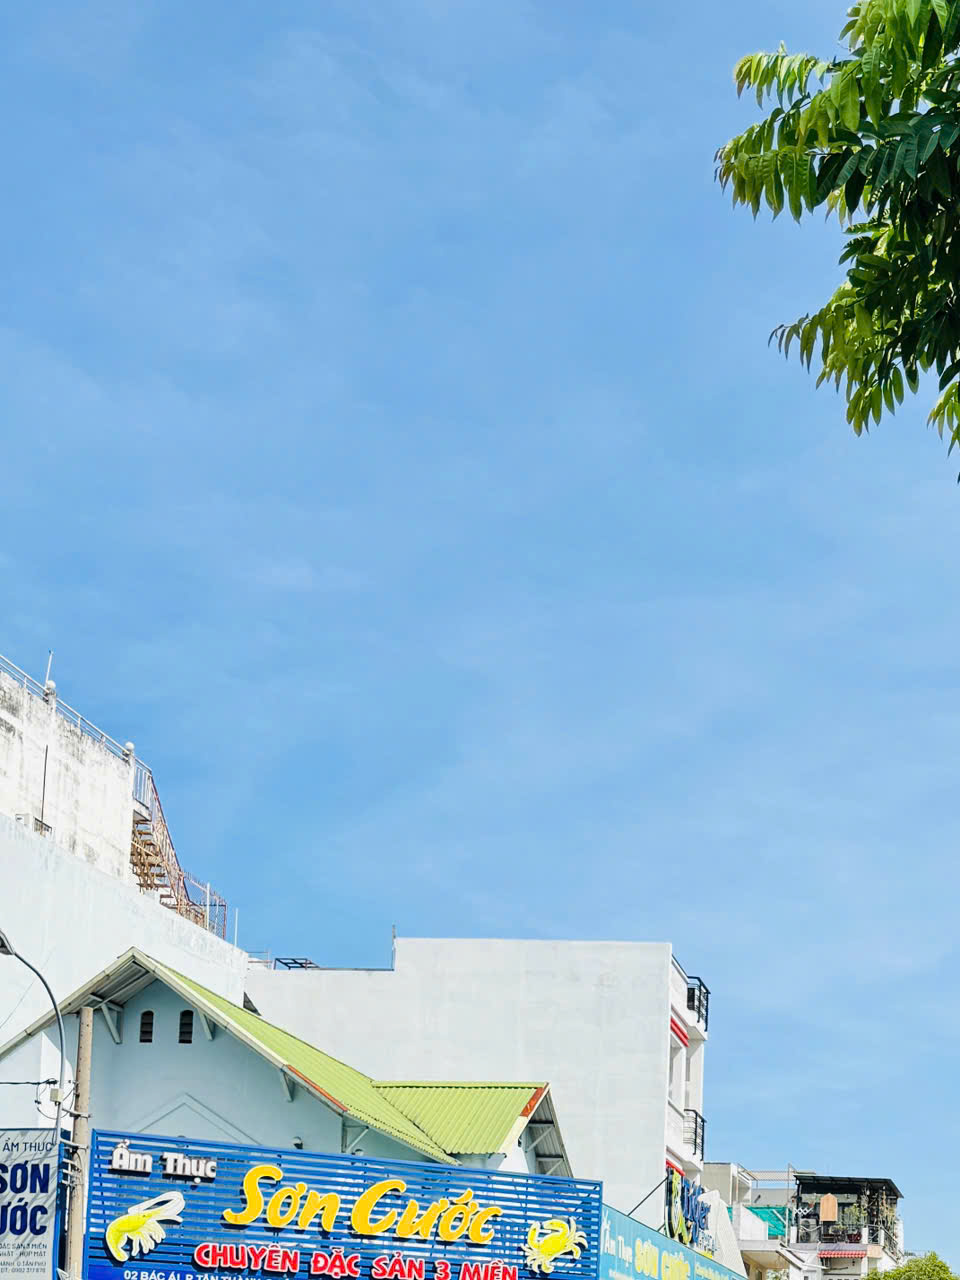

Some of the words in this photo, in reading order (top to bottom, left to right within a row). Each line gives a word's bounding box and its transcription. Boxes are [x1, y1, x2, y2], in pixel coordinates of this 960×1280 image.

[3, 1137, 20, 1152] ẨM
[111, 1139, 153, 1172] Ẩm
[162, 1151, 217, 1184] Thực
[222, 1164, 341, 1233] Sơn
[351, 1179, 503, 1244] Cước
[123, 1270, 138, 1280] 02
[194, 1242, 300, 1273] CHUYÊN
[311, 1247, 360, 1279] ĐẶC
[371, 1251, 425, 1280] SẢN
